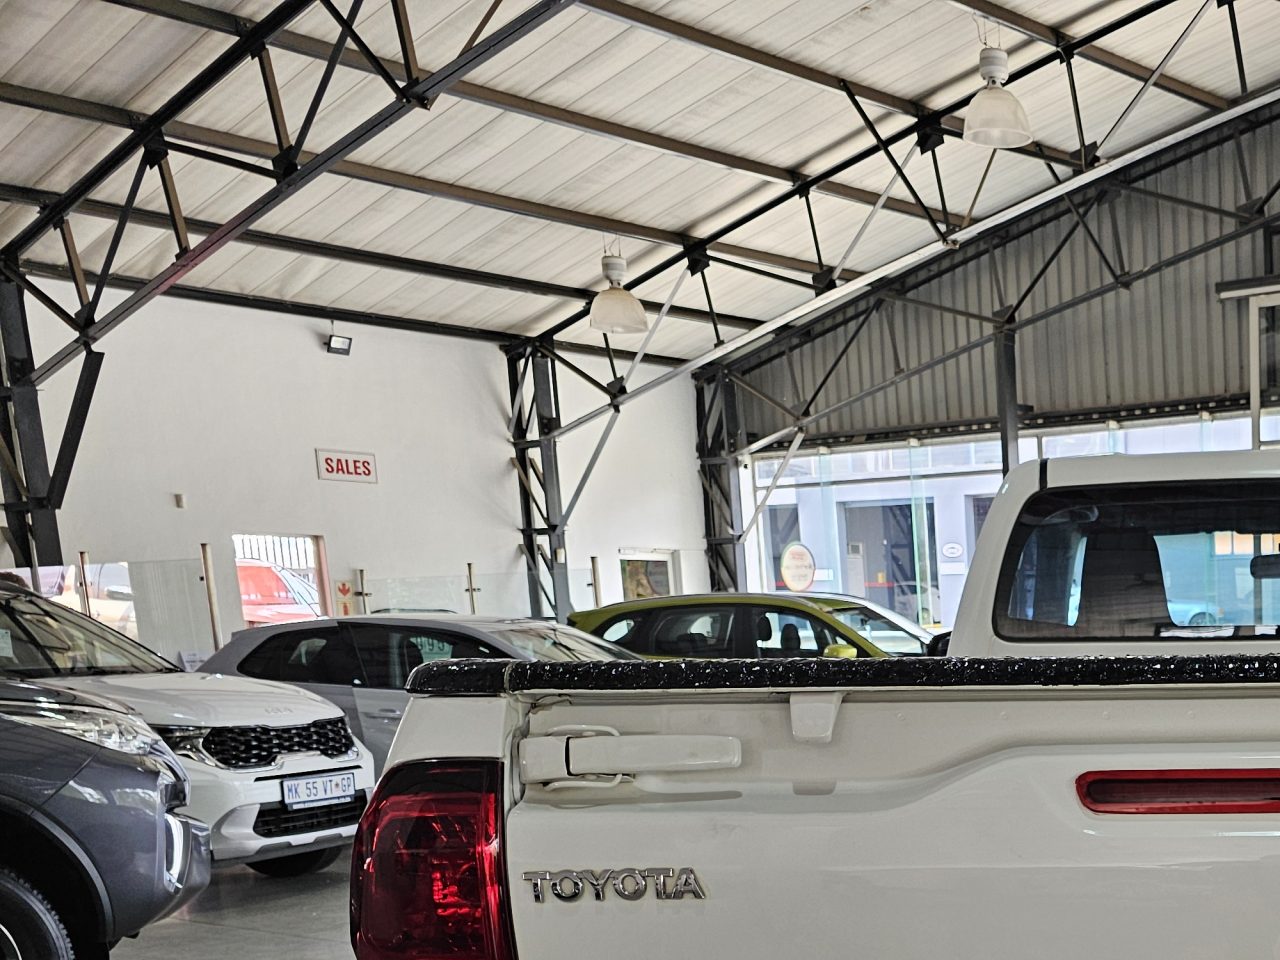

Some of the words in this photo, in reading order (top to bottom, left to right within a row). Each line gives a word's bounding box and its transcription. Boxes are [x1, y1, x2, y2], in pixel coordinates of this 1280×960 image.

[324, 457, 371, 476] SALES
[287, 782, 301, 800] MK
[305, 781, 319, 798] 55
[321, 779, 334, 796] VT
[340, 777, 352, 793] GP
[522, 867, 707, 903] TOYOTA
